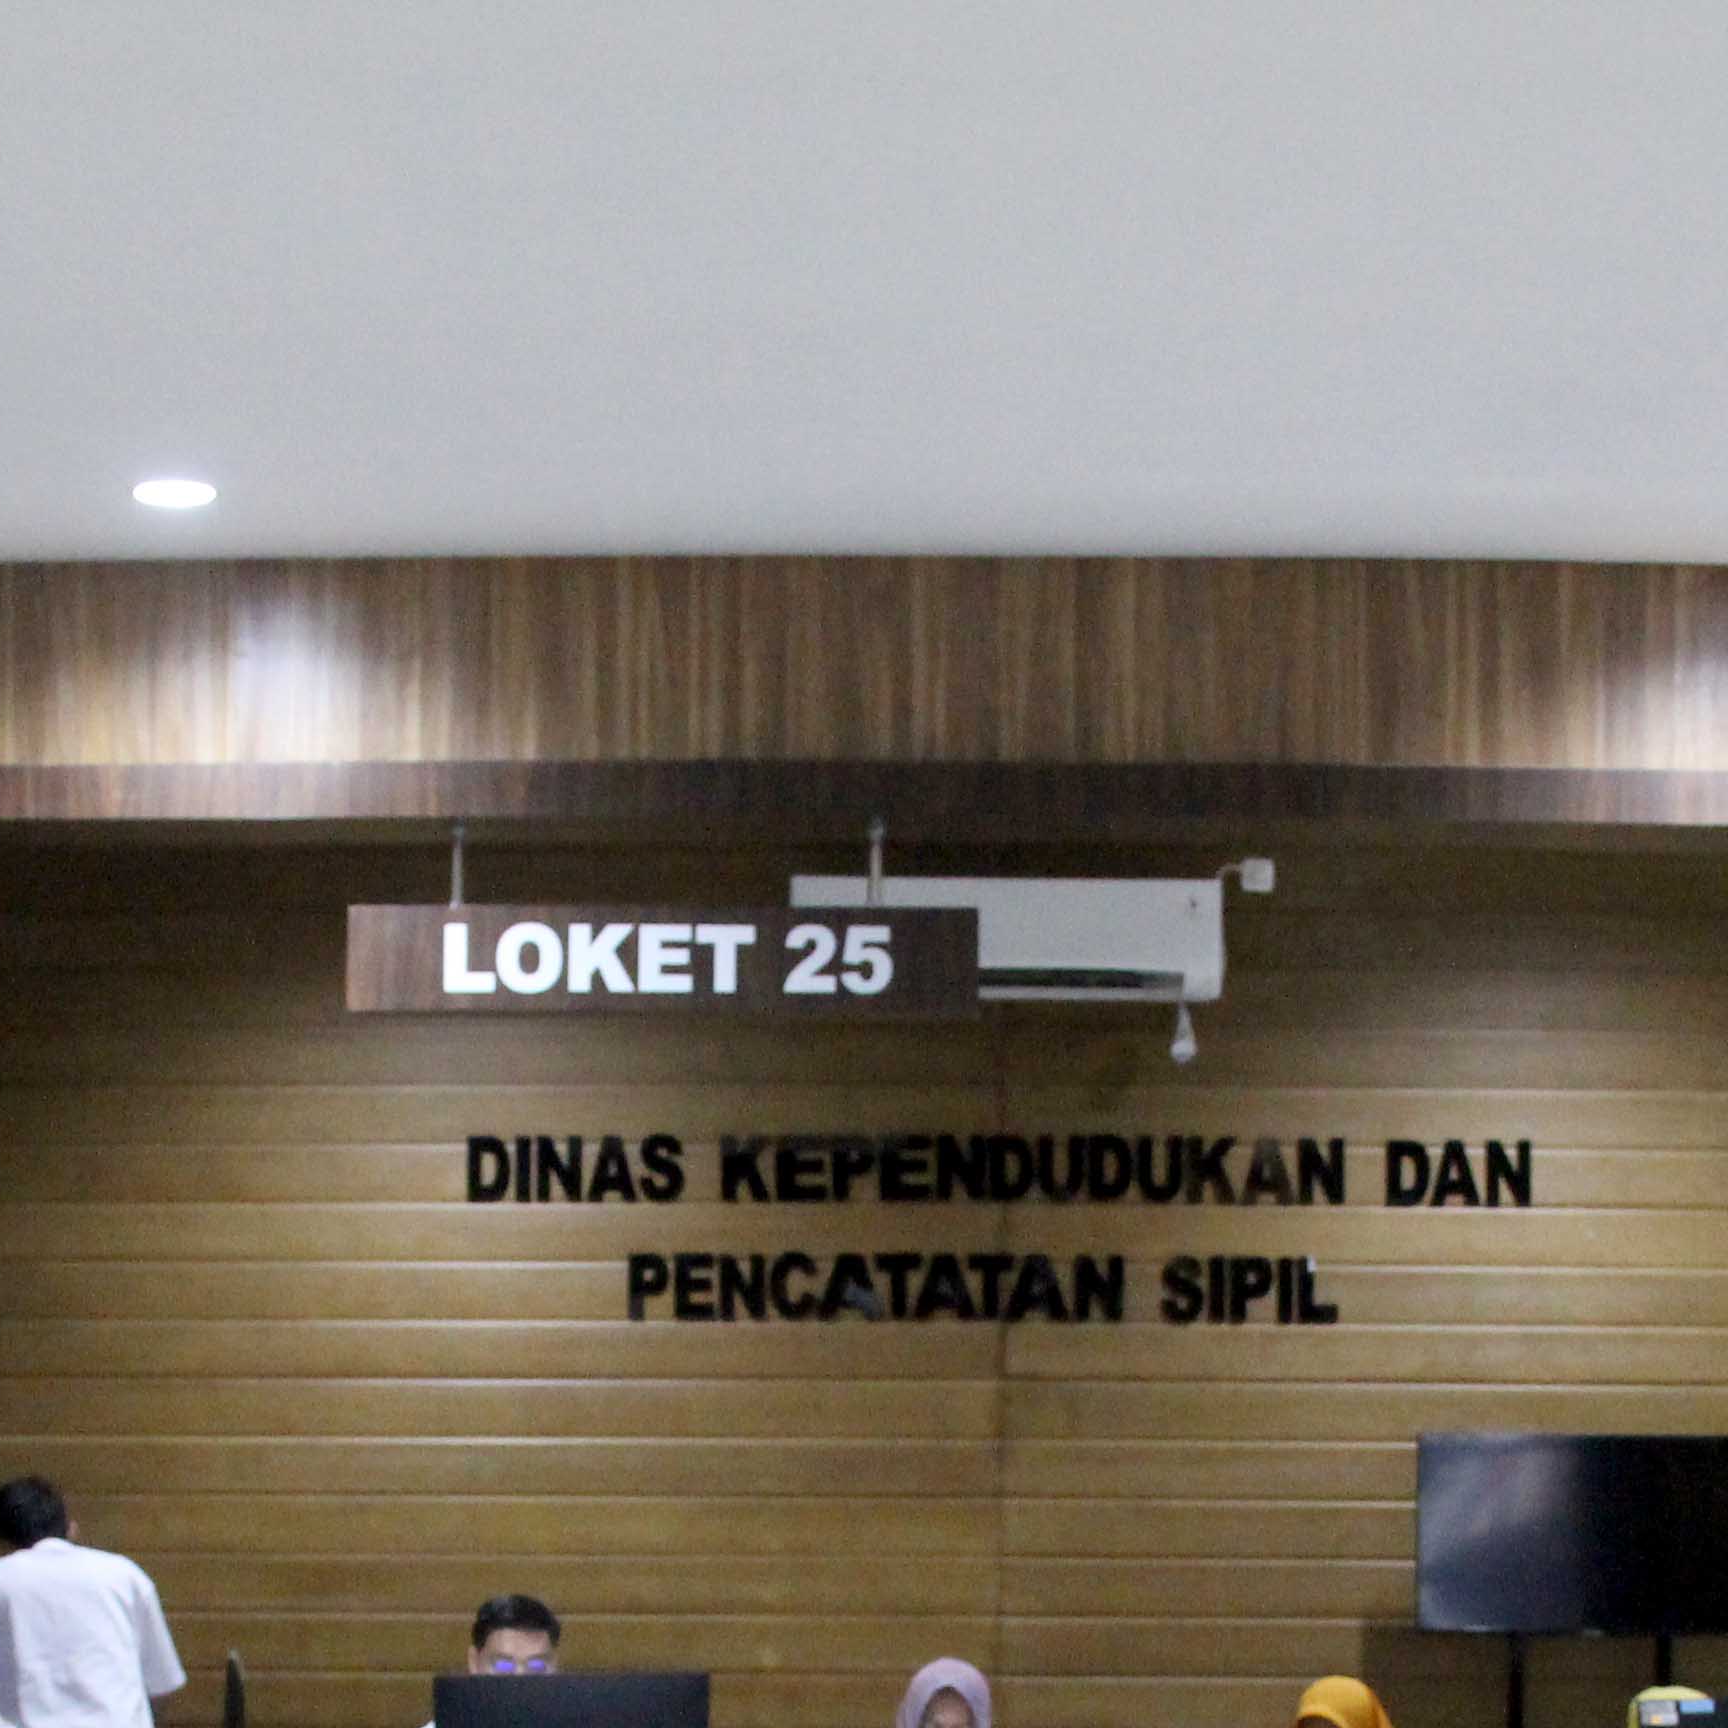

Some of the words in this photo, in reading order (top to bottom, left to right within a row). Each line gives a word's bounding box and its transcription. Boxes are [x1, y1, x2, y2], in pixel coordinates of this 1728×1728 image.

[442, 921, 757, 995] LOKET
[782, 922, 894, 995] 25
[467, 1134, 684, 1203] DINAS
[719, 1134, 1346, 1206] KEPENDUDUKAN
[1384, 1139, 1532, 1207] DAN
[627, 1251, 1125, 1324] PENCATATAN
[1160, 1254, 1339, 1325] SIPIL
